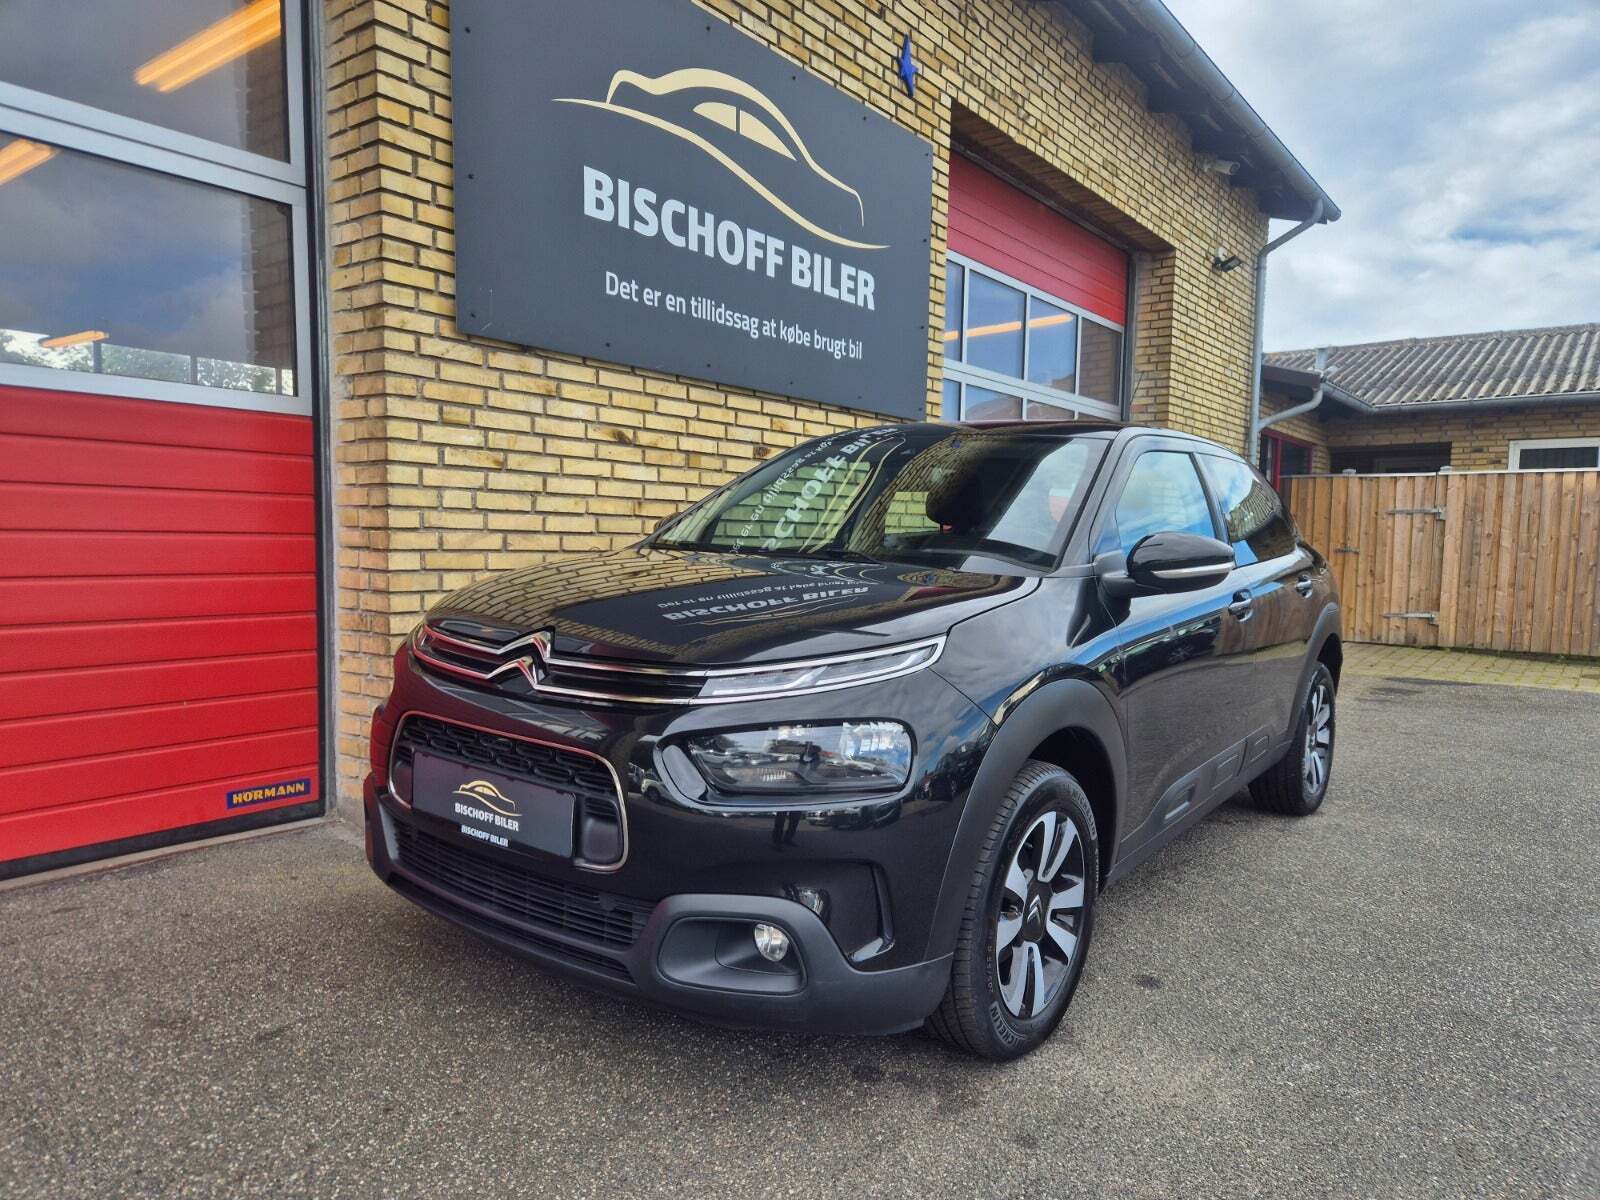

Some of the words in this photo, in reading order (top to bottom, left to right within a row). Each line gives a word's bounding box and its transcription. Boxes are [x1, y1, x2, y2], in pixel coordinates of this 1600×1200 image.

[583, 165, 785, 278] BISCHOFF
[791, 244, 876, 311] BILER
[605, 271, 639, 302] Det
[643, 287, 661, 308] er
[665, 293, 686, 315] en
[690, 296, 759, 339] tillidssag
[762, 318, 777, 338] at
[780, 319, 811, 347] købe
[814, 329, 847, 359] brugt
[849, 338, 863, 361] bil
[455, 802, 494, 823] BISCHOFF
[494, 815, 519, 832] BILER
[461, 825, 490, 841] BISCHOFF
[490, 834, 509, 847] BILER
